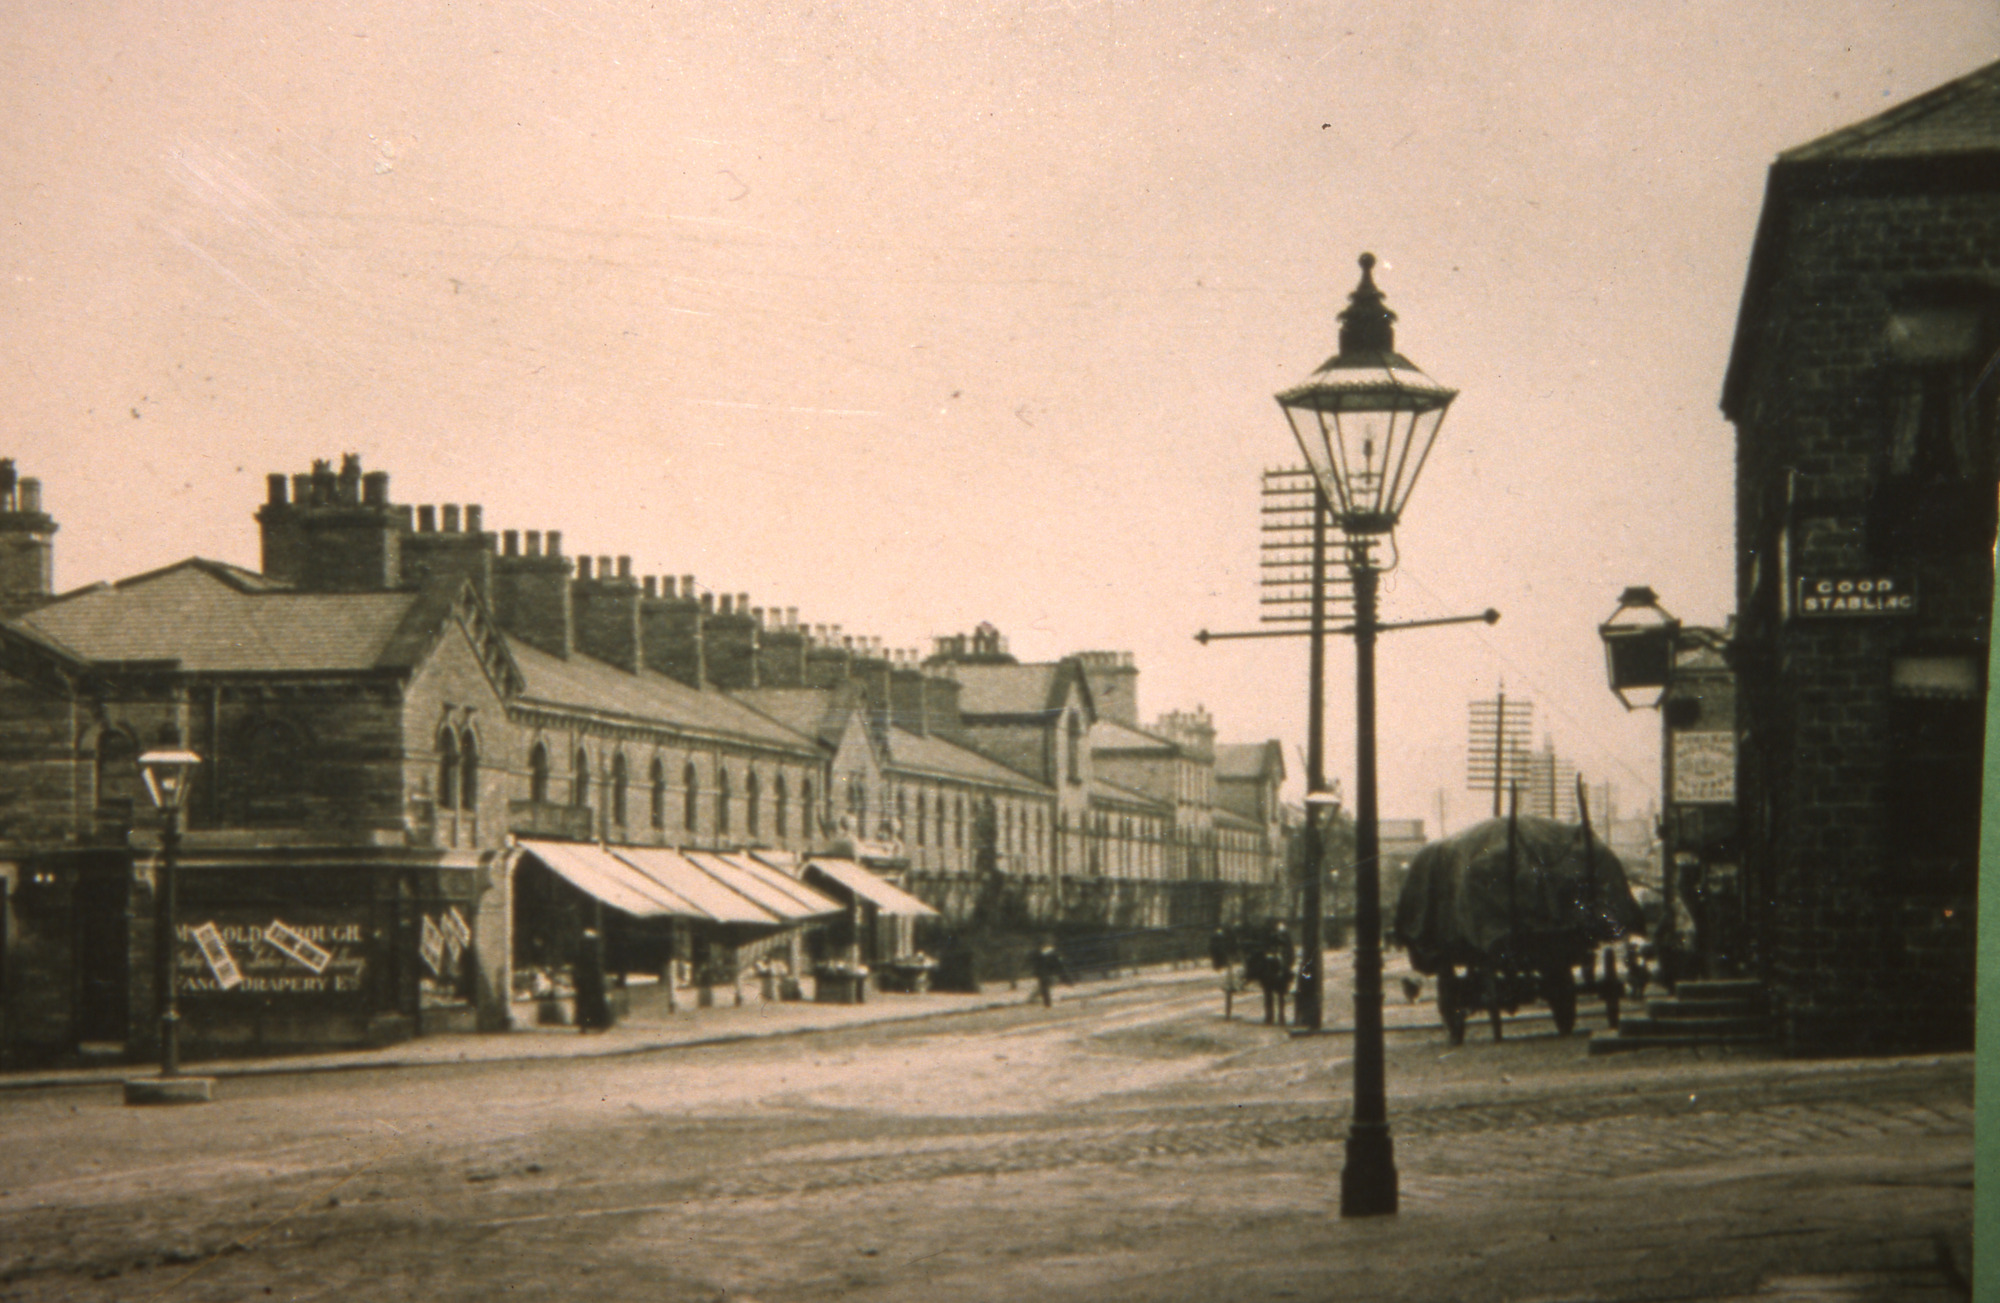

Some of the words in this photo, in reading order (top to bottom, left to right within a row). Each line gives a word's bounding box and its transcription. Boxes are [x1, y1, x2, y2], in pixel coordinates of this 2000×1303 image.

[1816, 580, 1892, 593] GOOD
[1804, 596, 1911, 610] STABLING
[240, 975, 328, 992] DRAPERY
